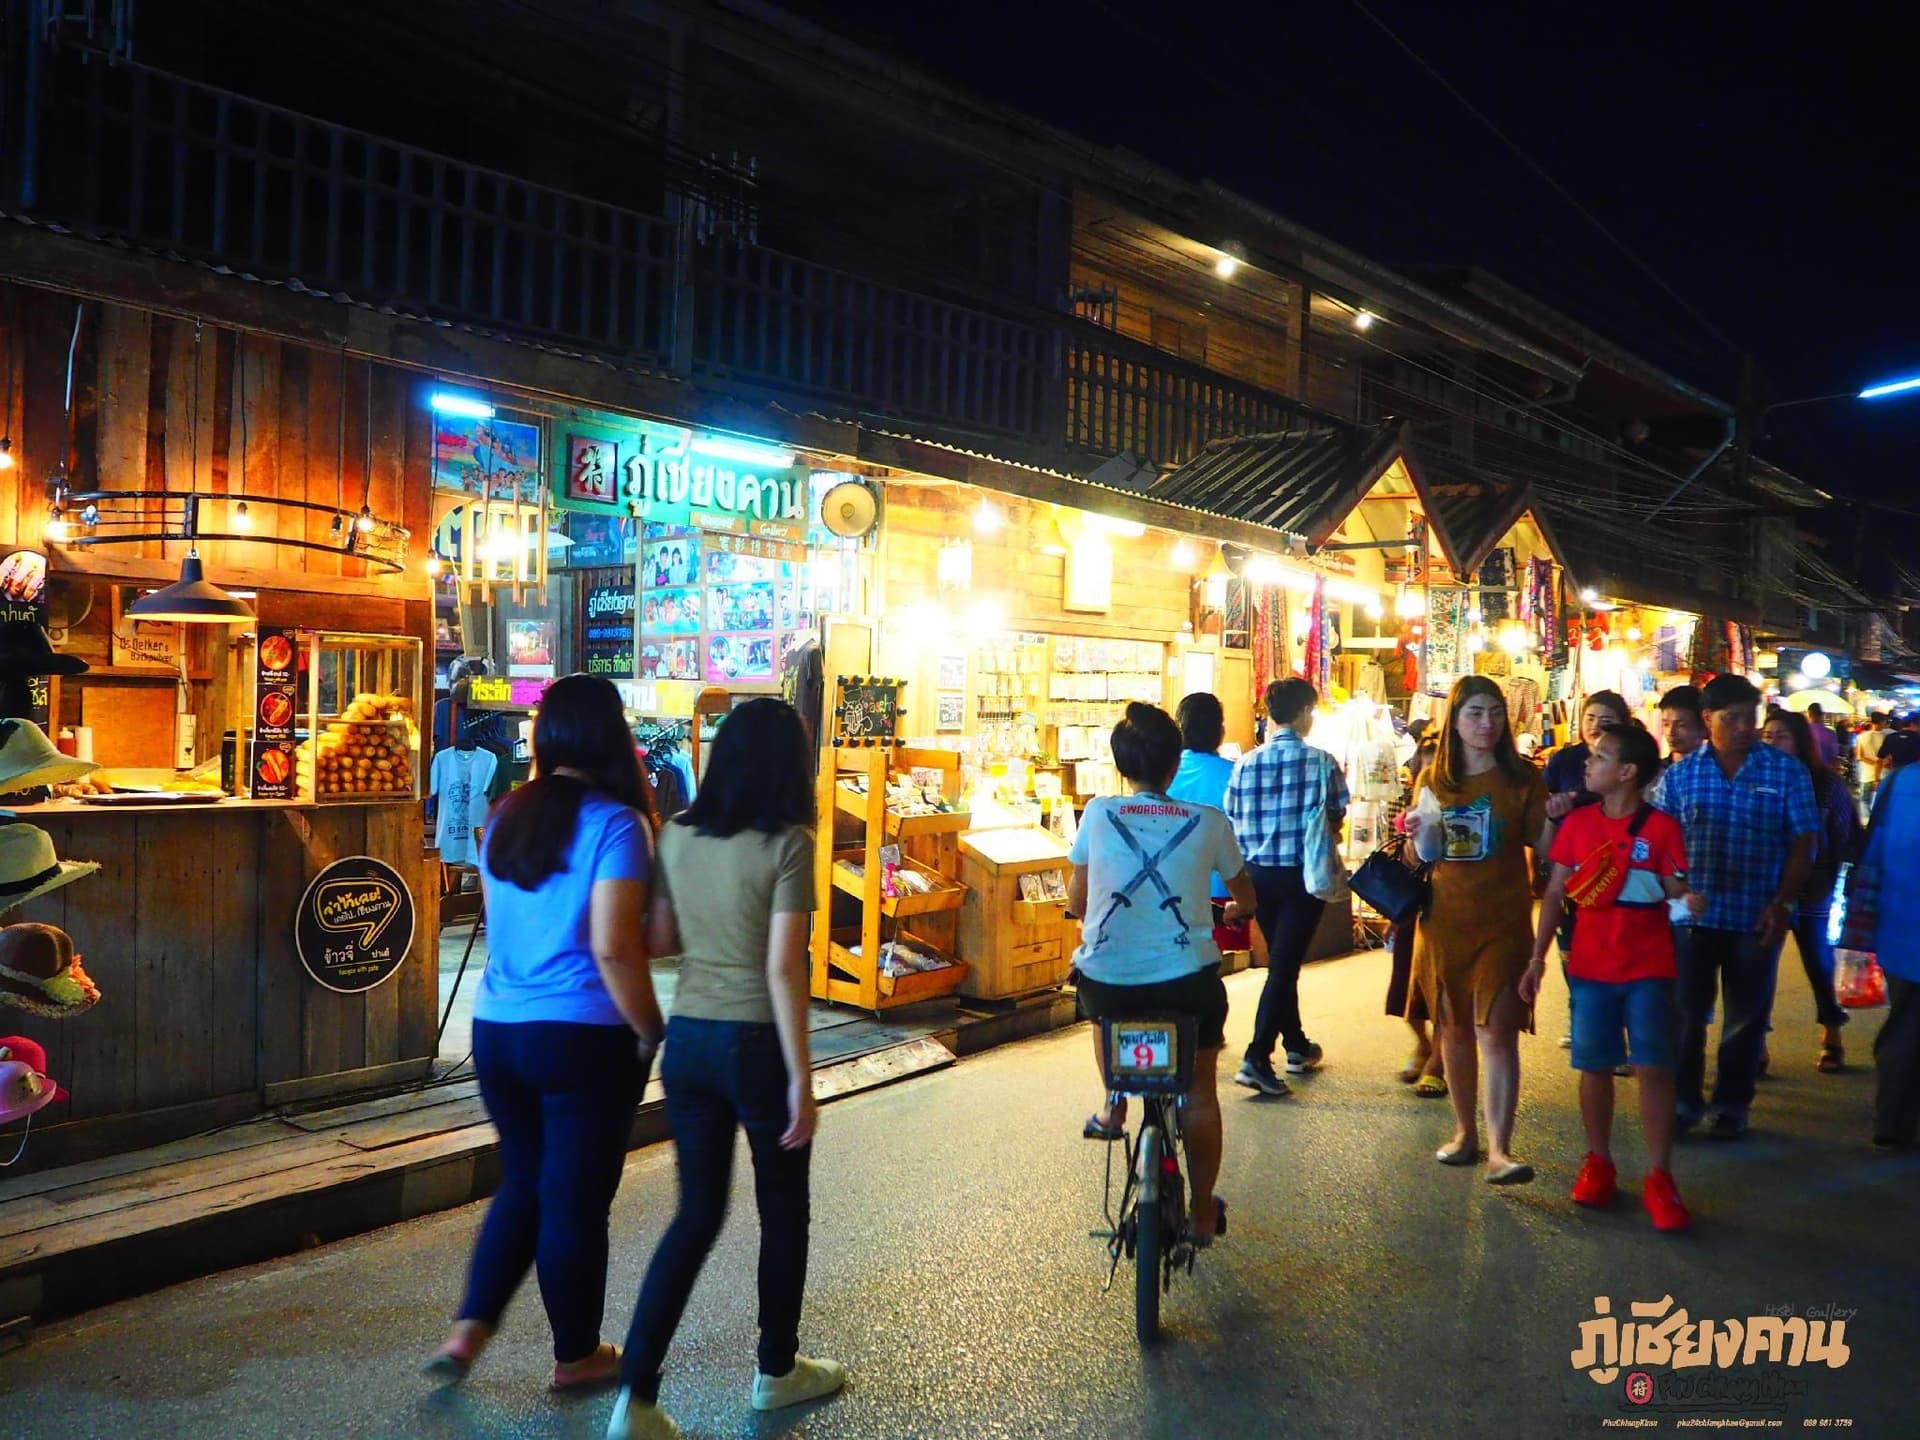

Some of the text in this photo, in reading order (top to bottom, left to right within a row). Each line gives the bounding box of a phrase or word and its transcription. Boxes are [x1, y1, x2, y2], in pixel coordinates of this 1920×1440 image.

[625, 434, 805, 521] ภู่เชียงคาน
[1119, 803, 1190, 819] SWORDSMAN
[1133, 1043, 1154, 1070] 9
